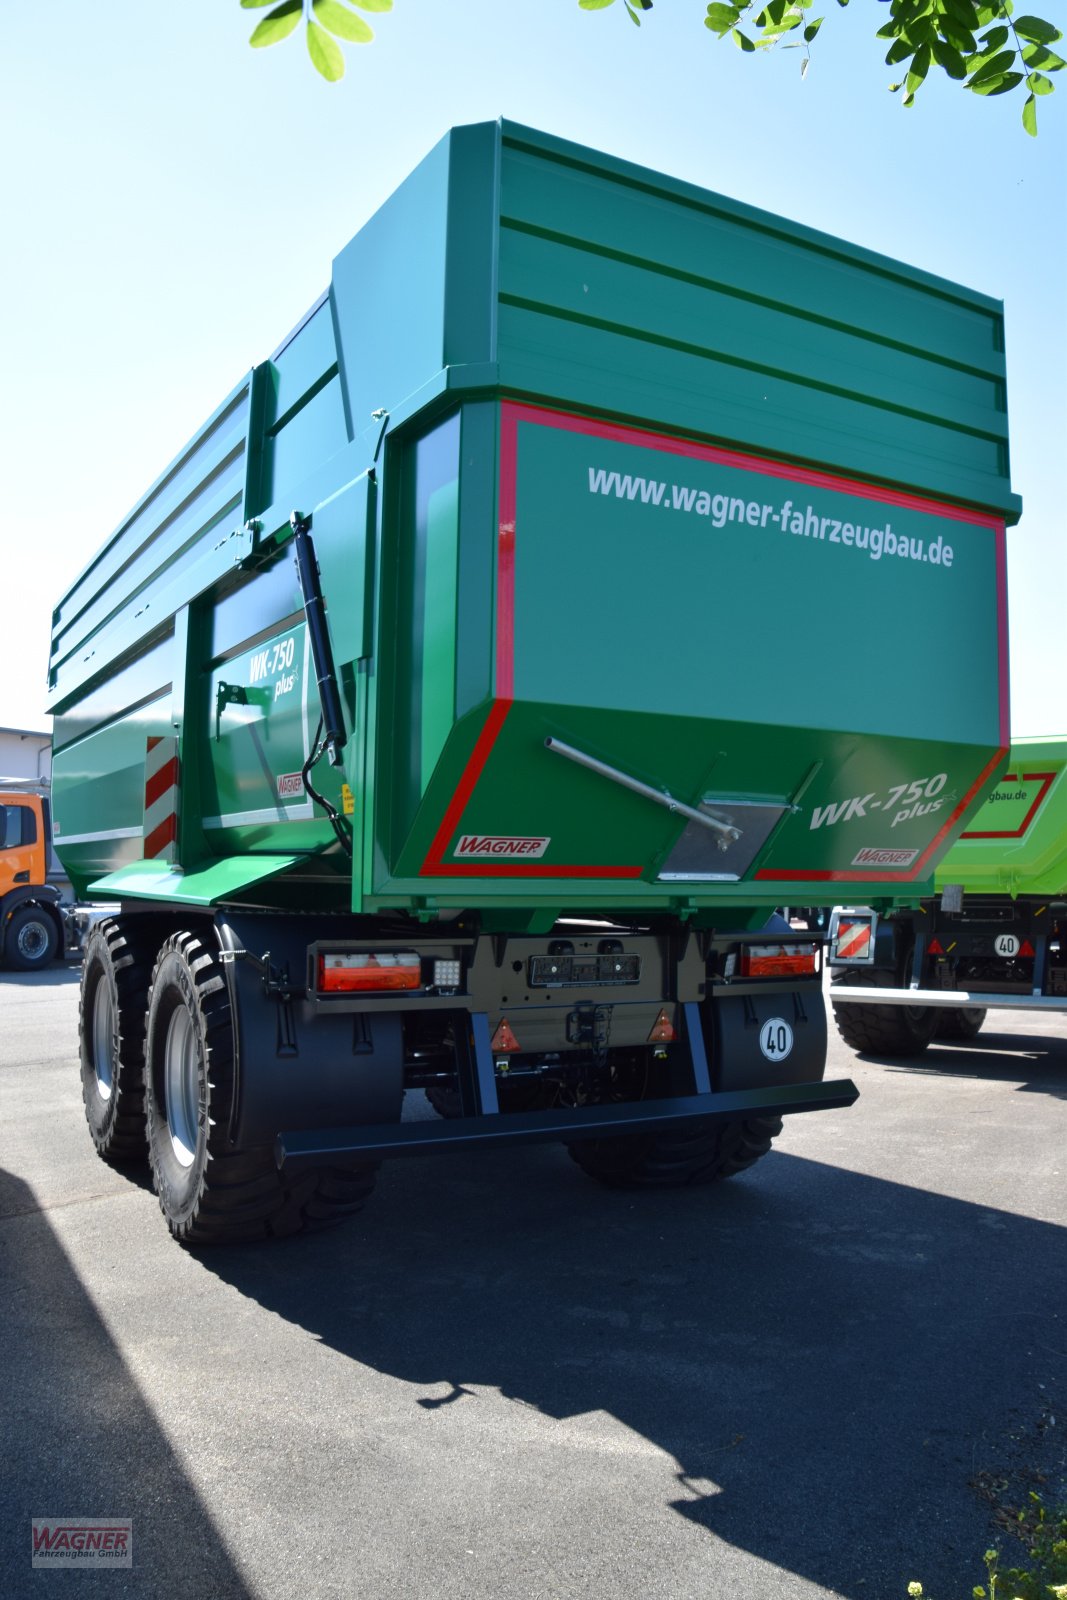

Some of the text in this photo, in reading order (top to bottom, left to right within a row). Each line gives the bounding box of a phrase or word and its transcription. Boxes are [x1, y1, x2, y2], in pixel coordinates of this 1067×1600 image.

[588, 467, 954, 567] www.wagner-fahrzeugbau.de
[250, 637, 295, 684] WK-750
[274, 673, 295, 702] plus
[810, 773, 947, 830] WK-750
[890, 799, 944, 828] plus
[460, 837, 545, 853] WAGNER
[857, 848, 915, 863] WAGNER
[1000, 937, 1014, 953] 40
[767, 1026, 786, 1053] 40
